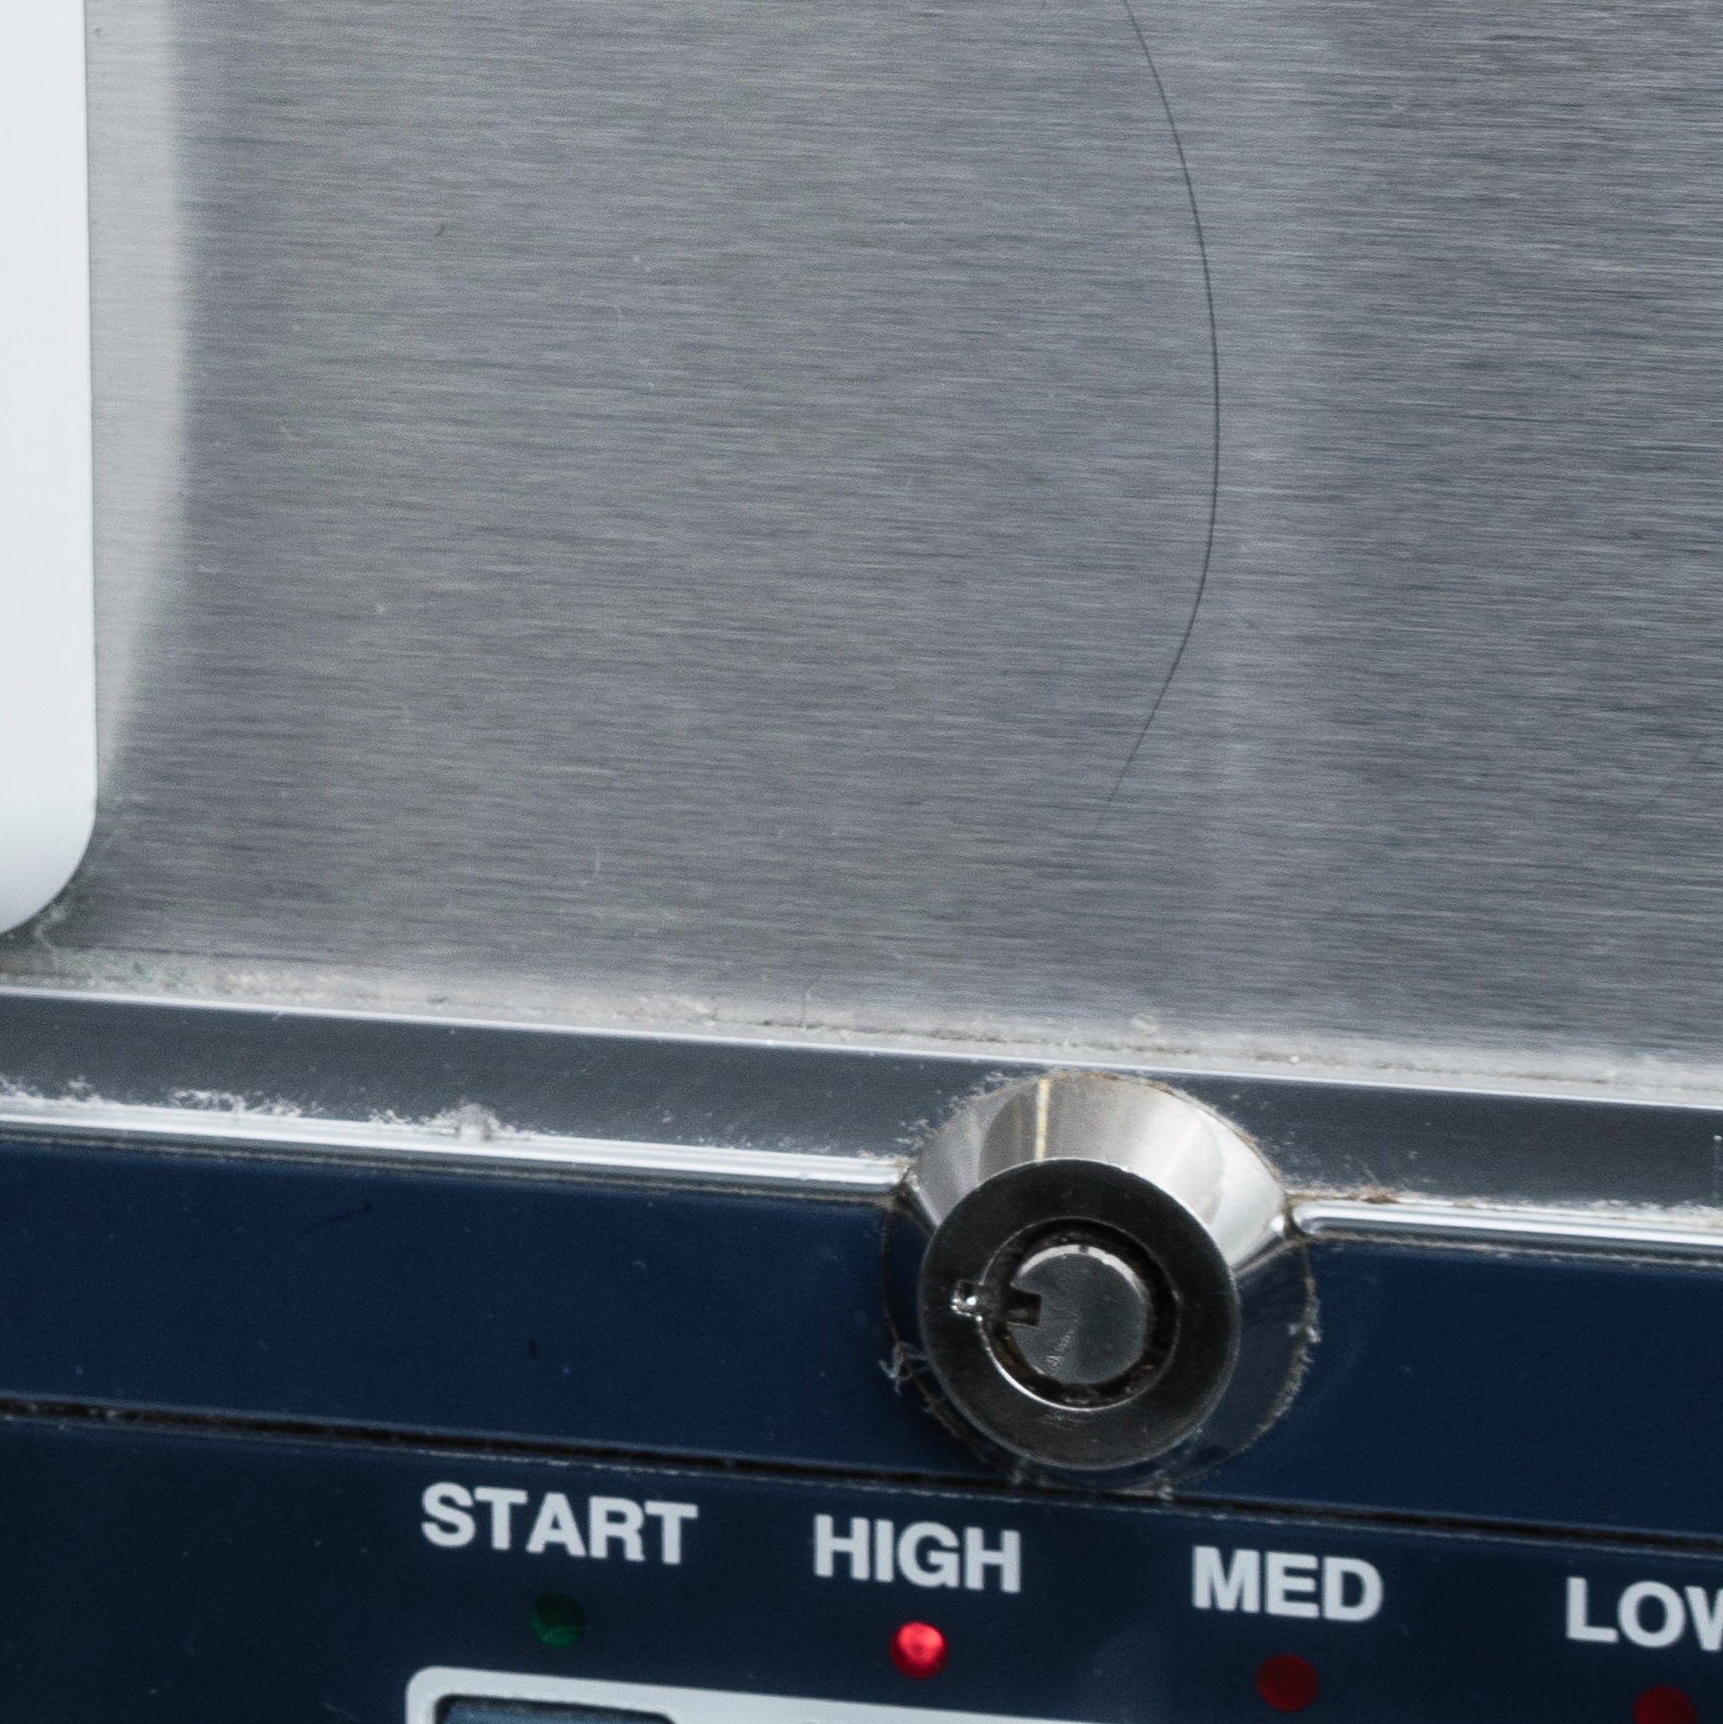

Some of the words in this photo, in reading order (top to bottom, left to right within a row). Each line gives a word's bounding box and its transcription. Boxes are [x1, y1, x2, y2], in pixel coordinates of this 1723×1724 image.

[421, 1481, 699, 1565] START
[814, 1513, 1021, 1594] HIGH
[1193, 1545, 1383, 1622] MED
